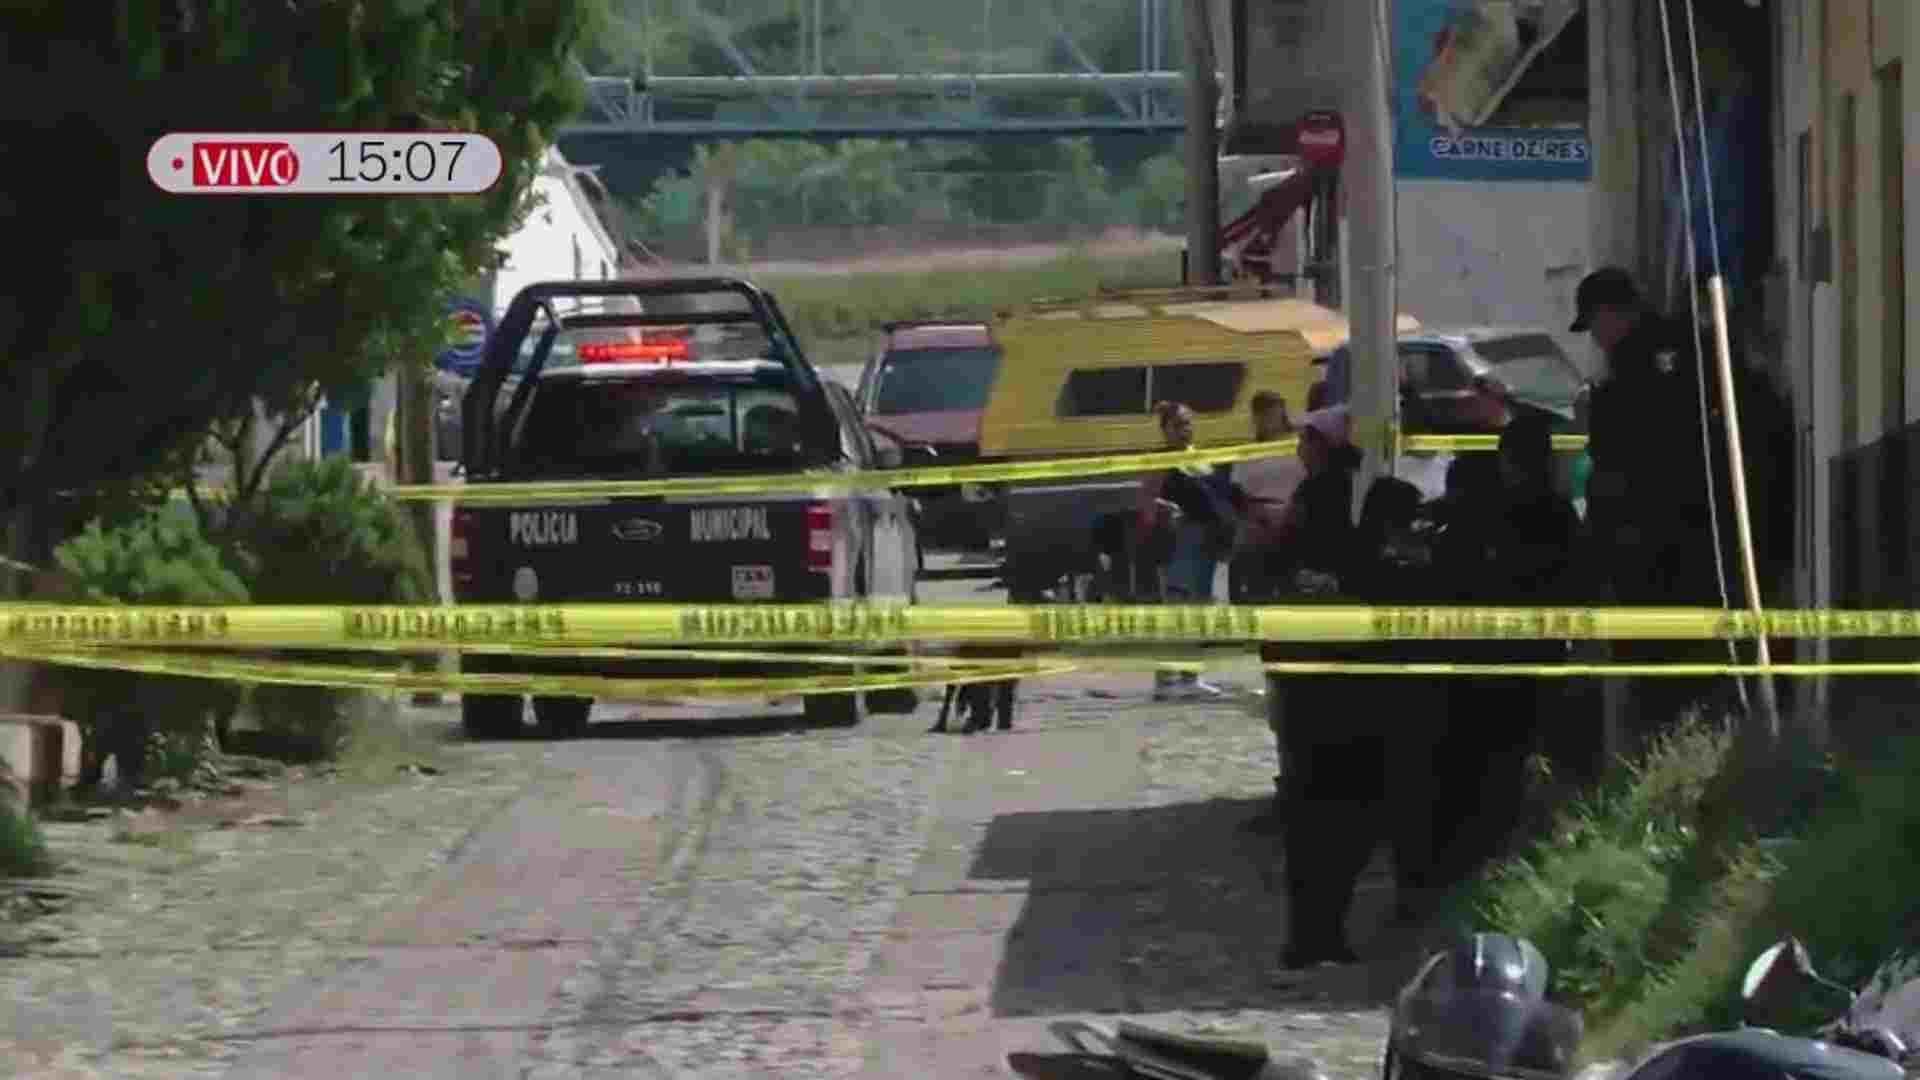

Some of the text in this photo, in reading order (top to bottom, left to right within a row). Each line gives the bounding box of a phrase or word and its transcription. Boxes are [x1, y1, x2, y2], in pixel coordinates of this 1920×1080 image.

[1431, 136, 1504, 159] CARNE
[1544, 137, 1588, 160] RES
[509, 511, 578, 545] POLICIA
[690, 506, 771, 542] MUNICIPAL
